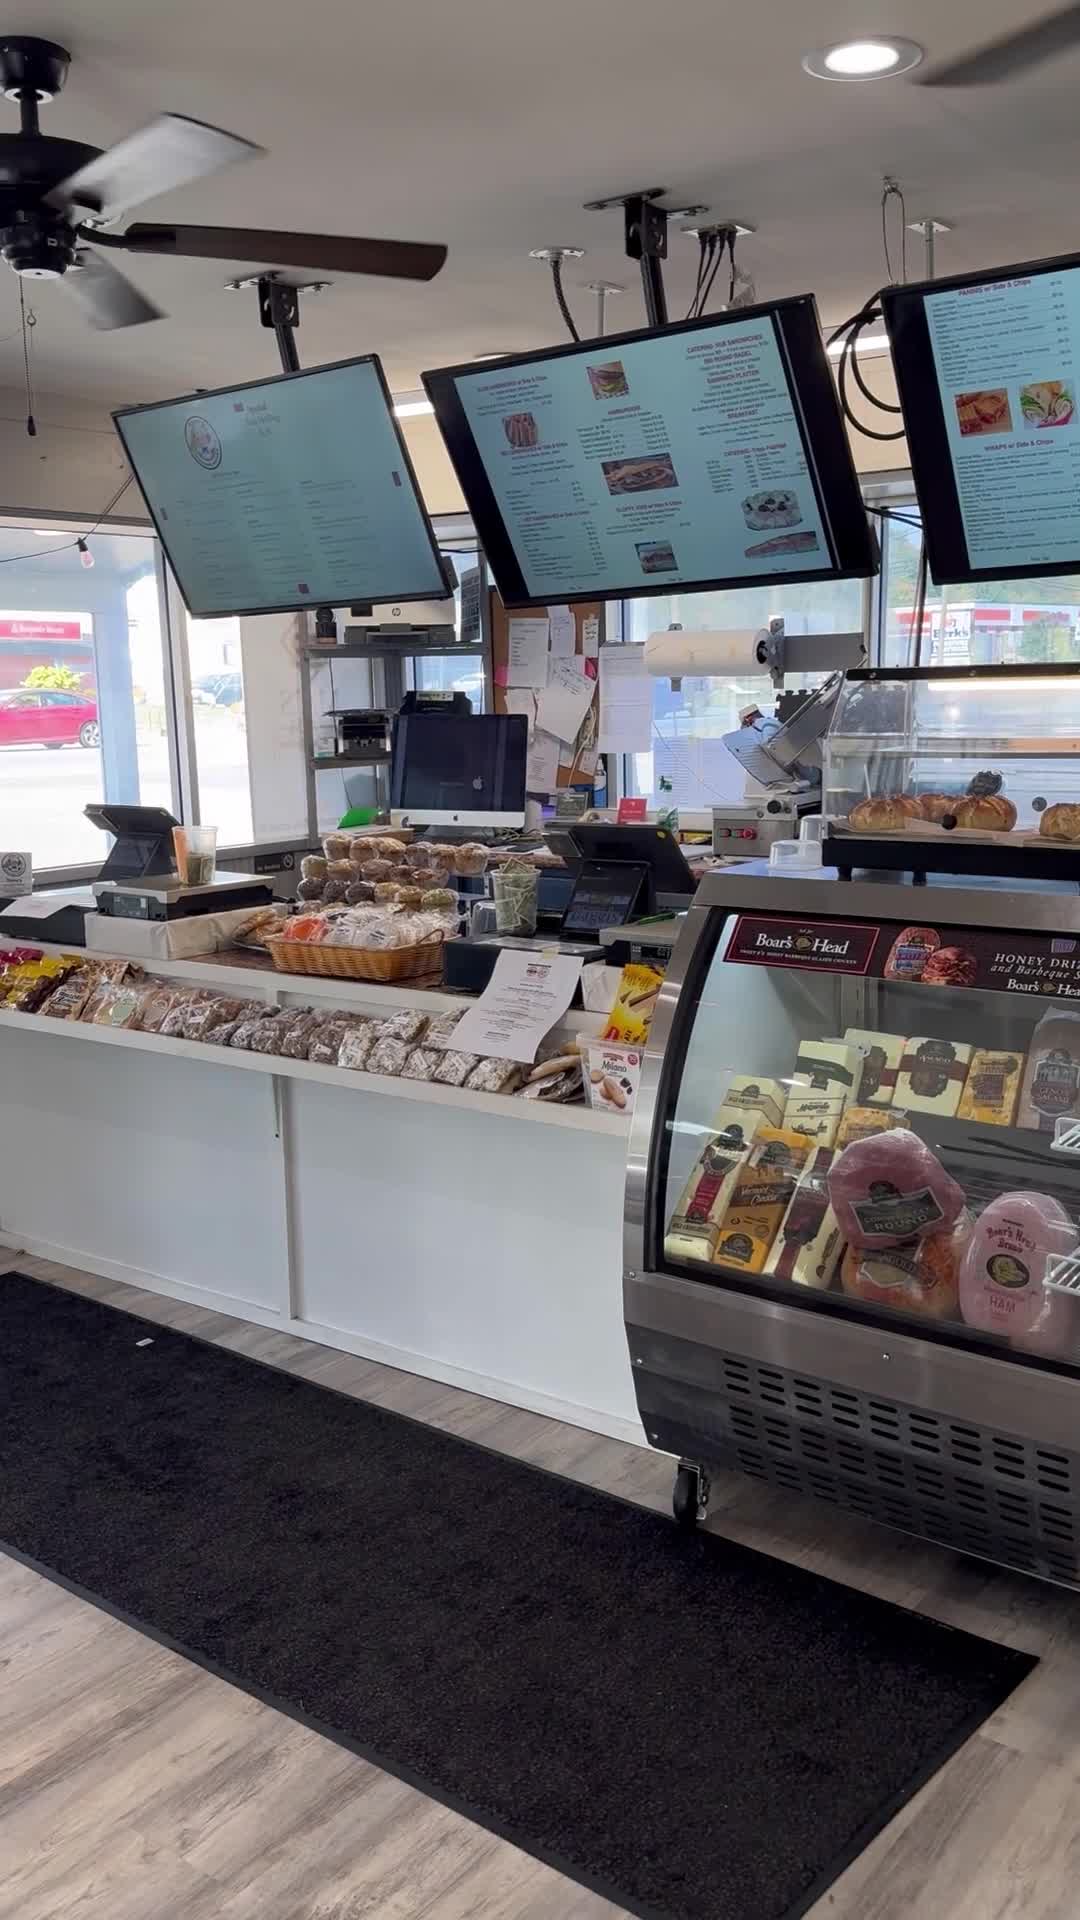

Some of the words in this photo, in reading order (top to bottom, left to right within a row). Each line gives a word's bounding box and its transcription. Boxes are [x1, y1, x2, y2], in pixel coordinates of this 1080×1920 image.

[755, 932, 793, 949] Boar's
[812, 938, 850, 954] Head
[994, 953, 1046, 966] HONEY
[990, 963, 1012, 973] and
[1016, 966, 1070, 980] Barbeque
[1007, 978, 1040, 992] Boar's
[602, 1061, 627, 1073] Milano
[874, 1214, 928, 1230] ROUND
[990, 1295, 1016, 1312] HAM
